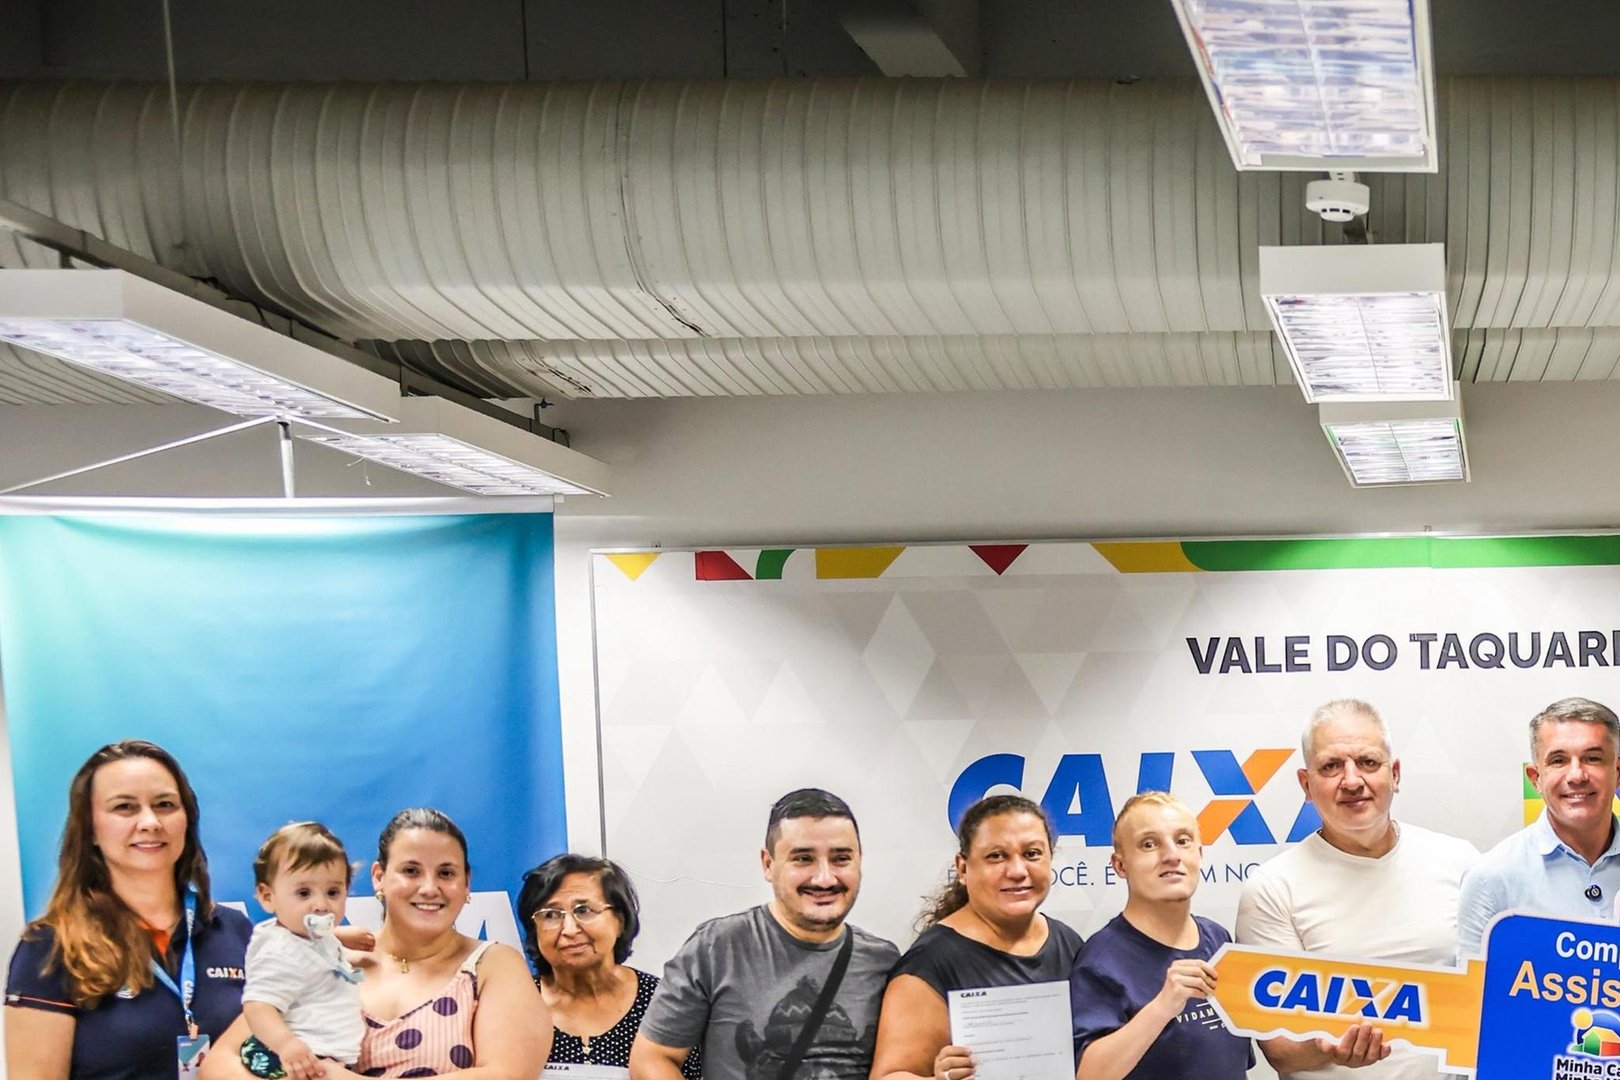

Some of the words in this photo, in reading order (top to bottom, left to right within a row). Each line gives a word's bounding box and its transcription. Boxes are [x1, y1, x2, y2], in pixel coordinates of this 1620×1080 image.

[1186, 635, 1311, 674] VALE
[1326, 633, 1398, 672] DO
[947, 748, 1322, 848] CAX
[206, 967, 245, 980] CAIXA
[960, 991, 988, 999] CAIXA
[1253, 969, 1422, 1023] CAIXA
[1556, 1058, 1602, 1075] Minha
